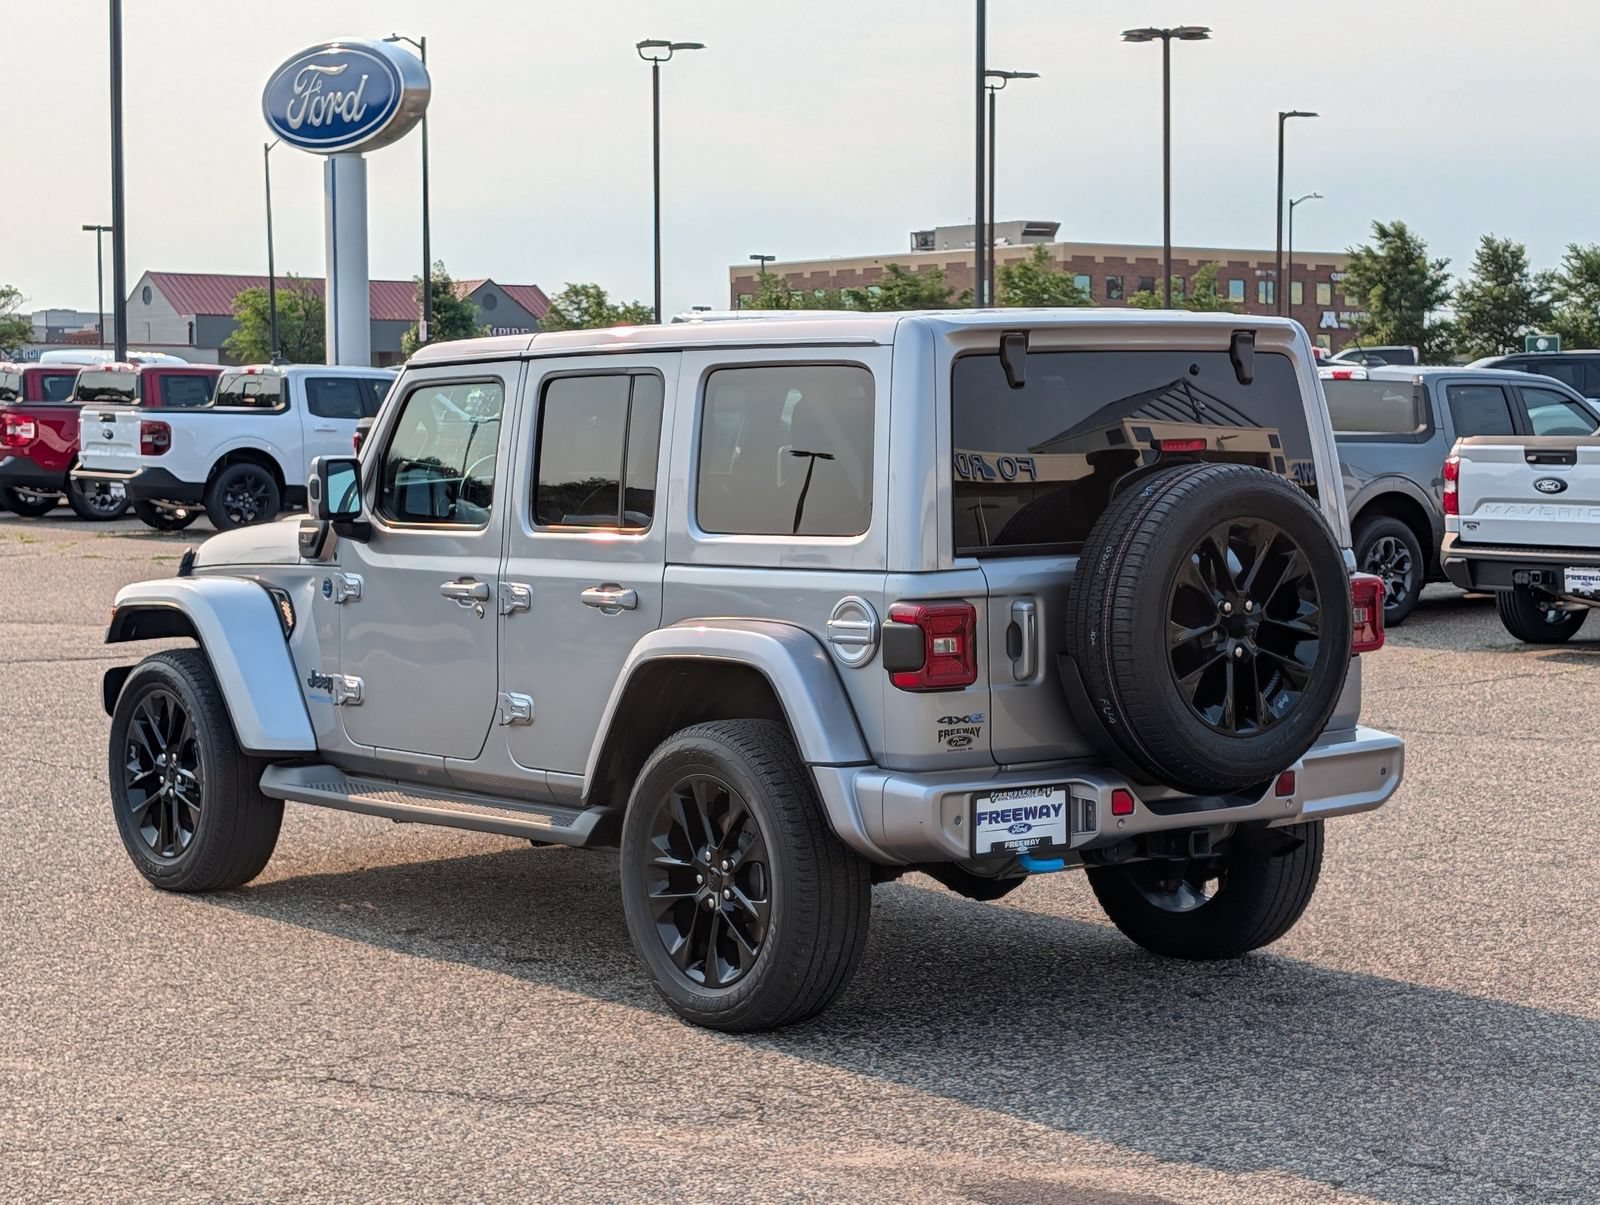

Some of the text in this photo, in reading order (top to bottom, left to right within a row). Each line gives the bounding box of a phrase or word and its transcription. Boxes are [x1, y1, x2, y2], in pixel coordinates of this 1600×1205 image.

[287, 64, 368, 129] Ford
[307, 669, 333, 695] Jeep
[938, 726, 981, 743] FREEWAY
[977, 803, 1063, 826] FREEWAY
[1004, 838, 1040, 849] FREEWAY
